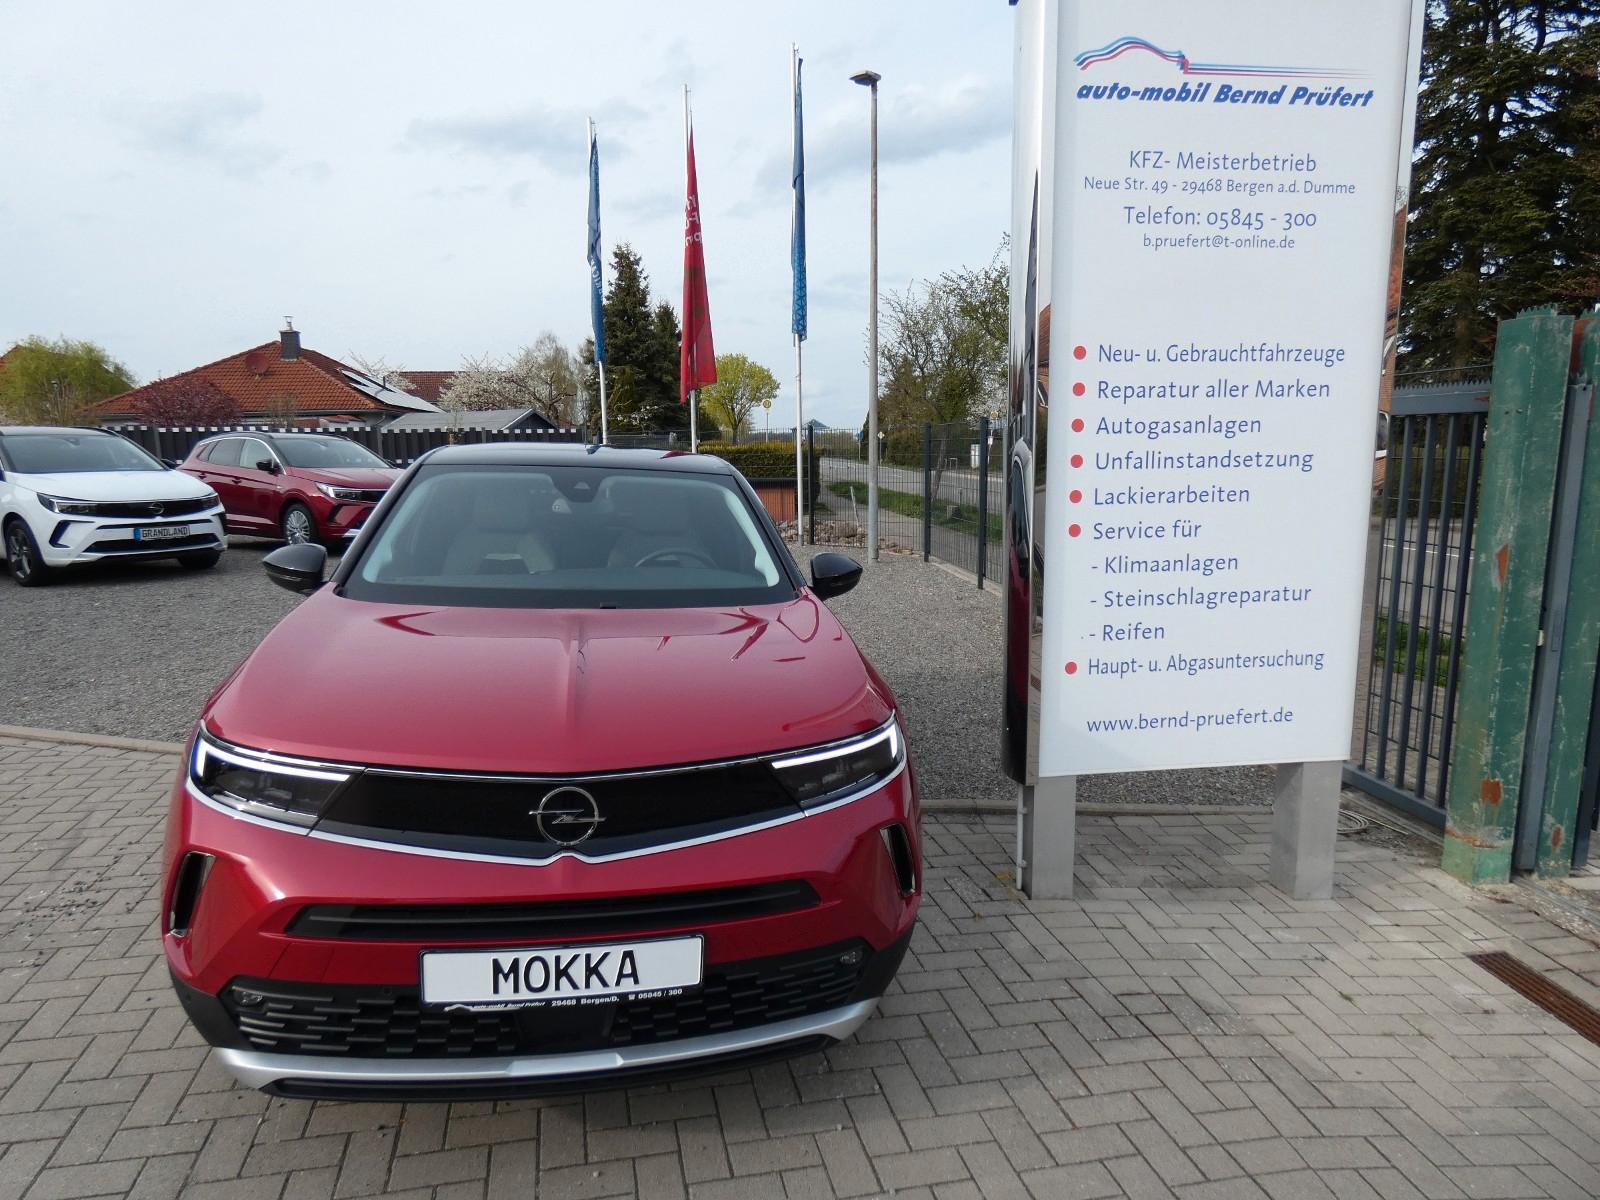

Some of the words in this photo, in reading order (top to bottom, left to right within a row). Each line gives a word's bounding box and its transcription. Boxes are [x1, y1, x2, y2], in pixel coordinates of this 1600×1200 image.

[1076, 81, 1212, 103] auto-mobil
[1212, 83, 1287, 106] Bernd
[1287, 85, 1375, 108] Prüfert
[1129, 150, 1171, 169] KFZ-
[1176, 151, 1317, 172] Meisterbetrieb
[1084, 175, 1120, 190] Neue
[1124, 176, 1149, 191] Str.
[1151, 179, 1169, 195] 49
[1181, 177, 1223, 195] 29468
[1226, 178, 1274, 197] Bergen
[1277, 179, 1300, 194] a.d.
[1303, 180, 1356, 194] Dumme
[1122, 205, 1201, 226] Telefon:
[1206, 207, 1264, 231] 05845
[1282, 212, 1317, 232] 300
[1143, 233, 1296, 252] b.pruefert@t-online.de
[1098, 343, 1141, 363] Neu-
[1146, 348, 1161, 363] u.
[1166, 342, 1346, 368] Gebrauchtfahrzeuge
[1097, 380, 1200, 405] Reparatur
[1205, 378, 1250, 401] aller
[1254, 377, 1330, 399] Marken
[1095, 414, 1261, 441] Autogasanlagen
[1095, 449, 1315, 473] Unfallinstandsetzung
[1093, 484, 1250, 506] Lackierarbeiten
[142, 526, 188, 538] GRANDLAND
[1093, 520, 1166, 541] Service
[1171, 519, 1203, 539] für
[1104, 553, 1239, 577] Klimaanlagen
[1103, 585, 1312, 610] Steinschlagreparatur
[1102, 621, 1165, 642] Reifen
[1088, 657, 1142, 680] Haupt-
[1148, 659, 1162, 673] u.
[1166, 648, 1326, 676] Abgasuntersuchung
[1086, 705, 1294, 733] www.bernd-pruefert.de
[492, 950, 640, 995] MOKKA
[551, 999, 577, 1007] 29468
